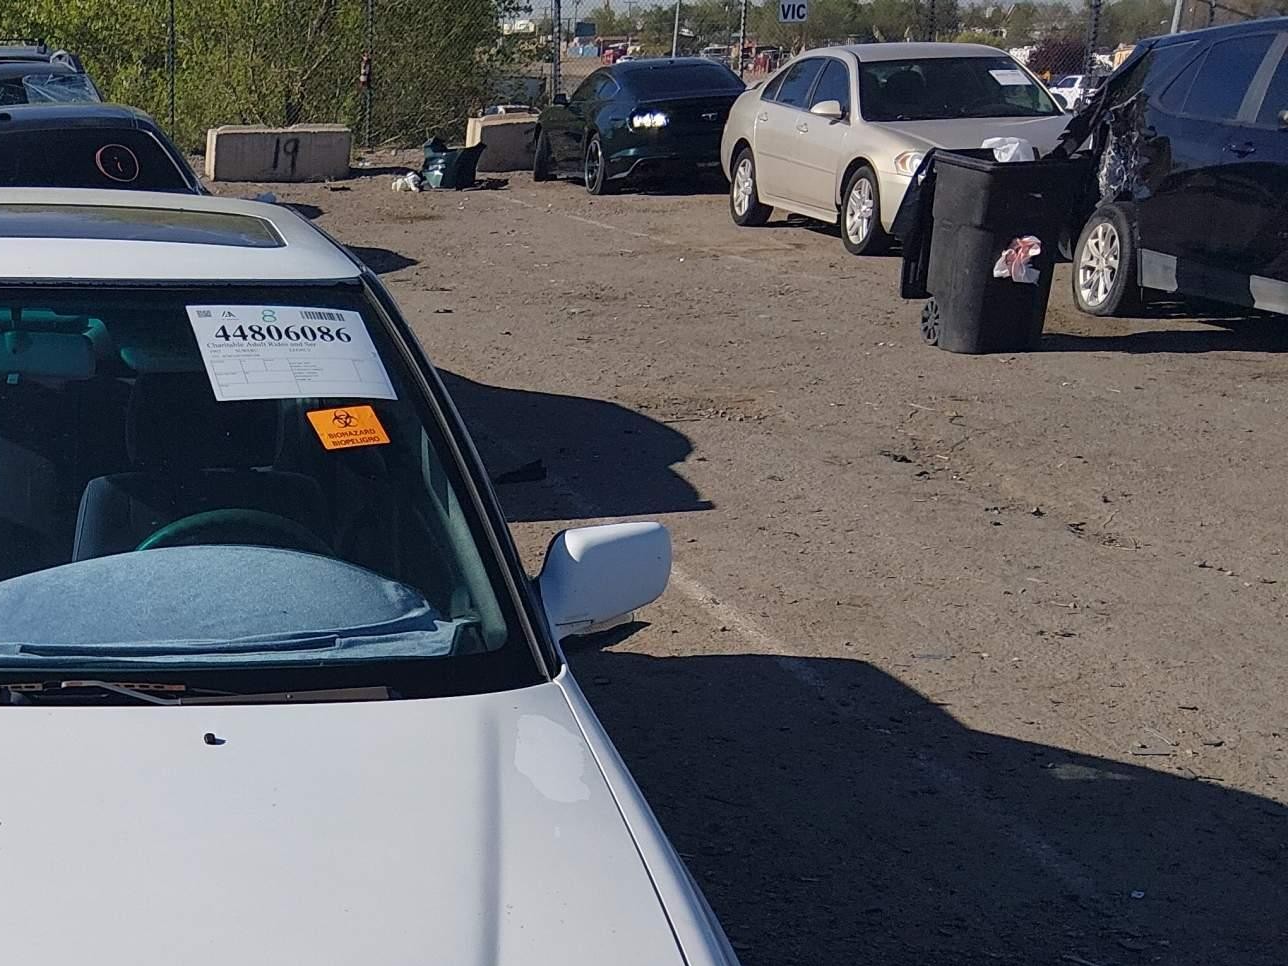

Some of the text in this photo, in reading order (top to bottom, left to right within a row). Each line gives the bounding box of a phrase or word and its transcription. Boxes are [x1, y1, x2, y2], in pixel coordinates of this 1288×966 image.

[781, 3, 806, 20] VIC
[272, 136, 300, 177] 19
[215, 325, 352, 342] 44806086
[328, 428, 376, 438] BIOHAZARD
[332, 436, 380, 446] BIOPELIGRO
